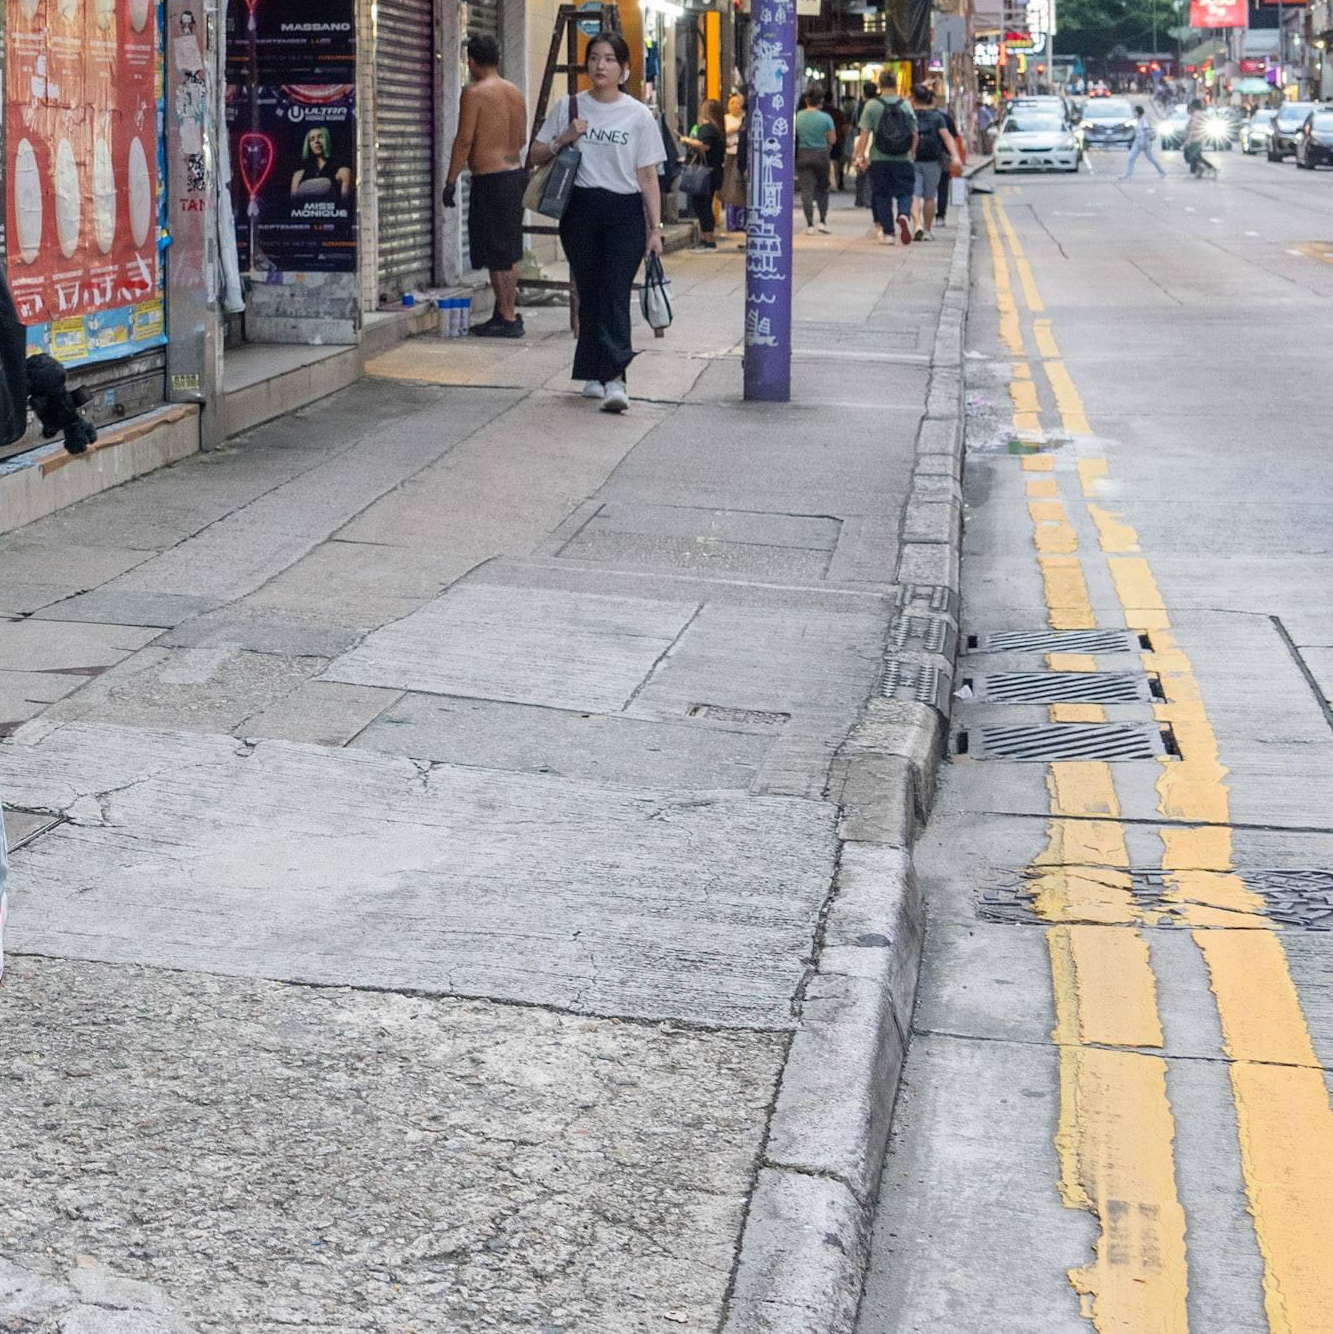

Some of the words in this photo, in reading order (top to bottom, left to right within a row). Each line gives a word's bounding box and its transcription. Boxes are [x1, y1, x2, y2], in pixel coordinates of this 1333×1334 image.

[280, 22, 351, 32] MASSANO
[304, 107, 347, 117] ULTRA
[303, 202, 335, 210] MISS
[290, 209, 348, 218] MONIQUE
